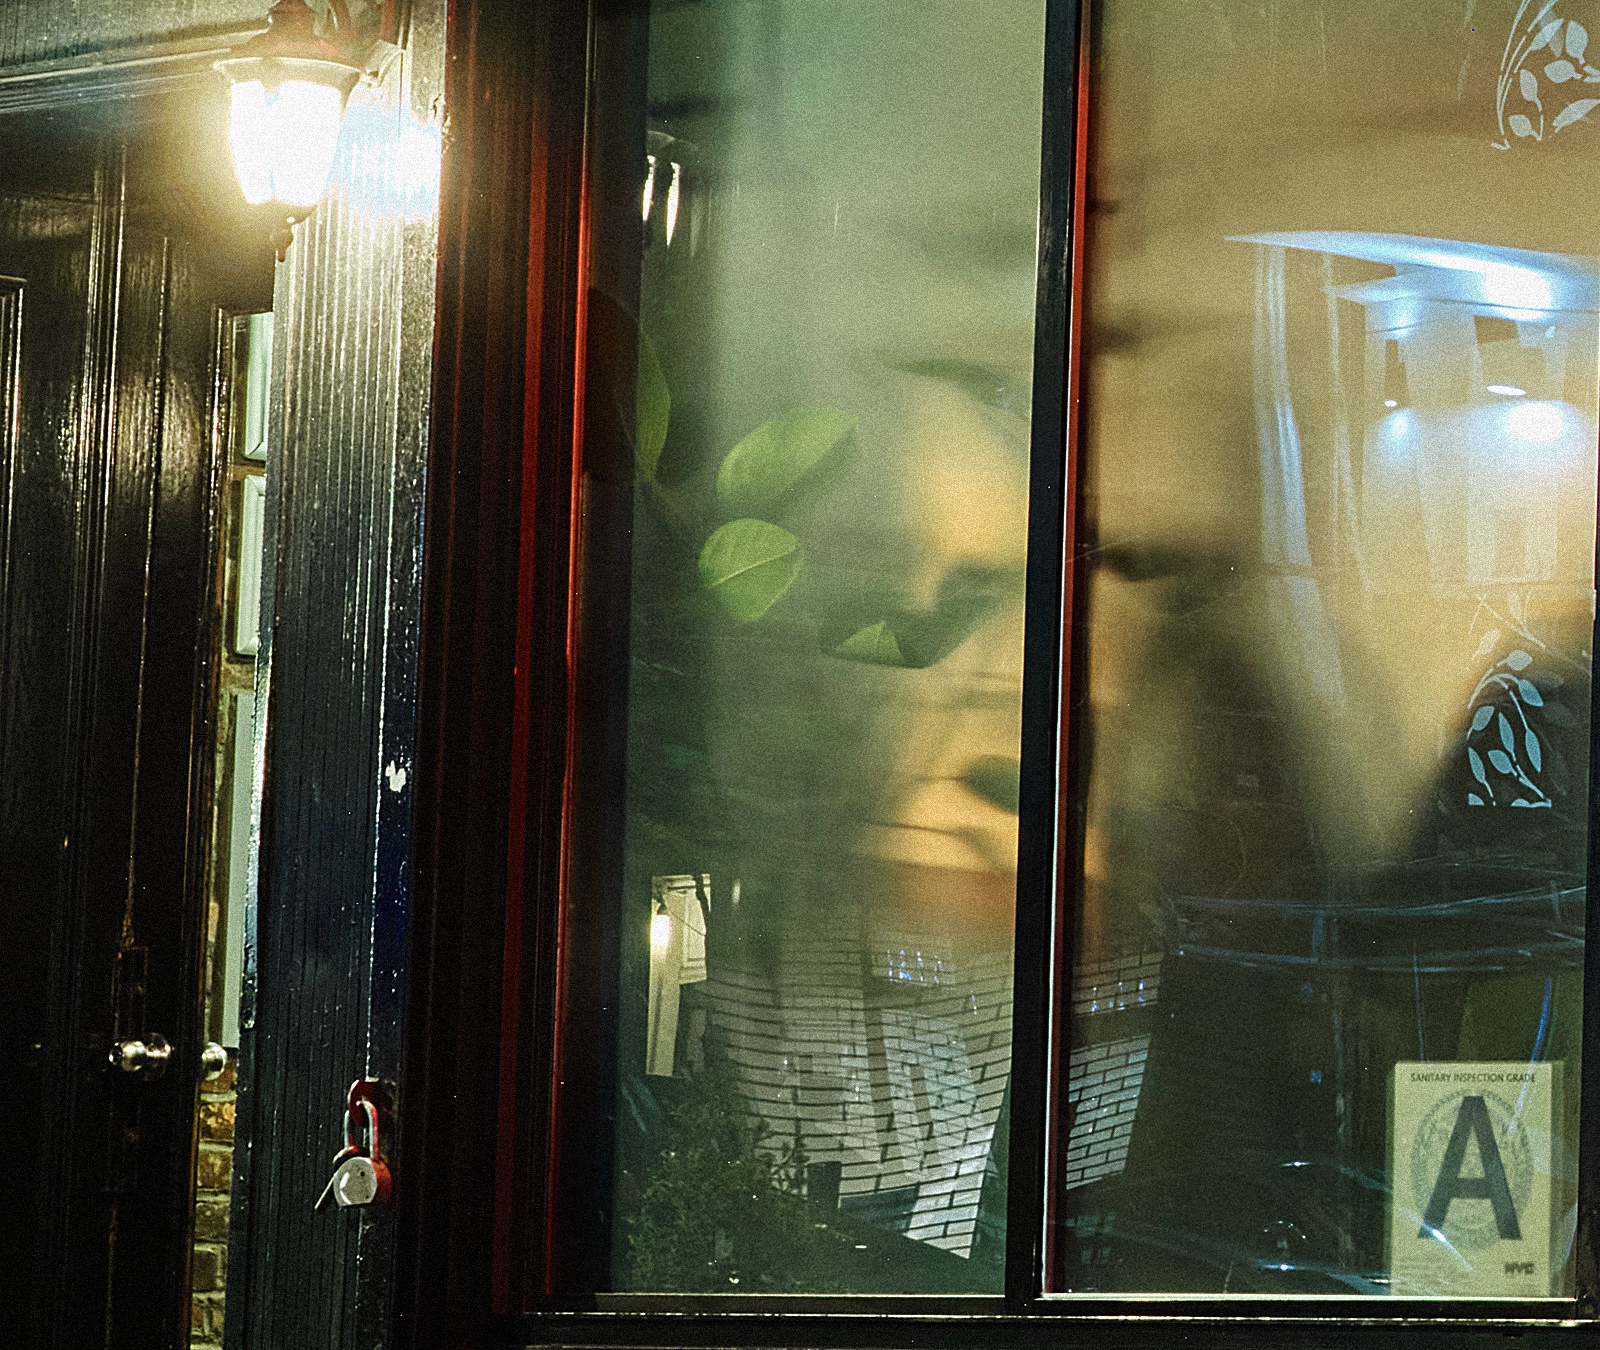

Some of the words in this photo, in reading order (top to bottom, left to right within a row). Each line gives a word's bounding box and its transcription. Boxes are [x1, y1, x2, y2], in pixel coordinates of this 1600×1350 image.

[1411, 1073, 1451, 1083] SANITARY
[1453, 1073, 1504, 1083] INSPECTION
[1417, 1096, 1523, 1240] A
